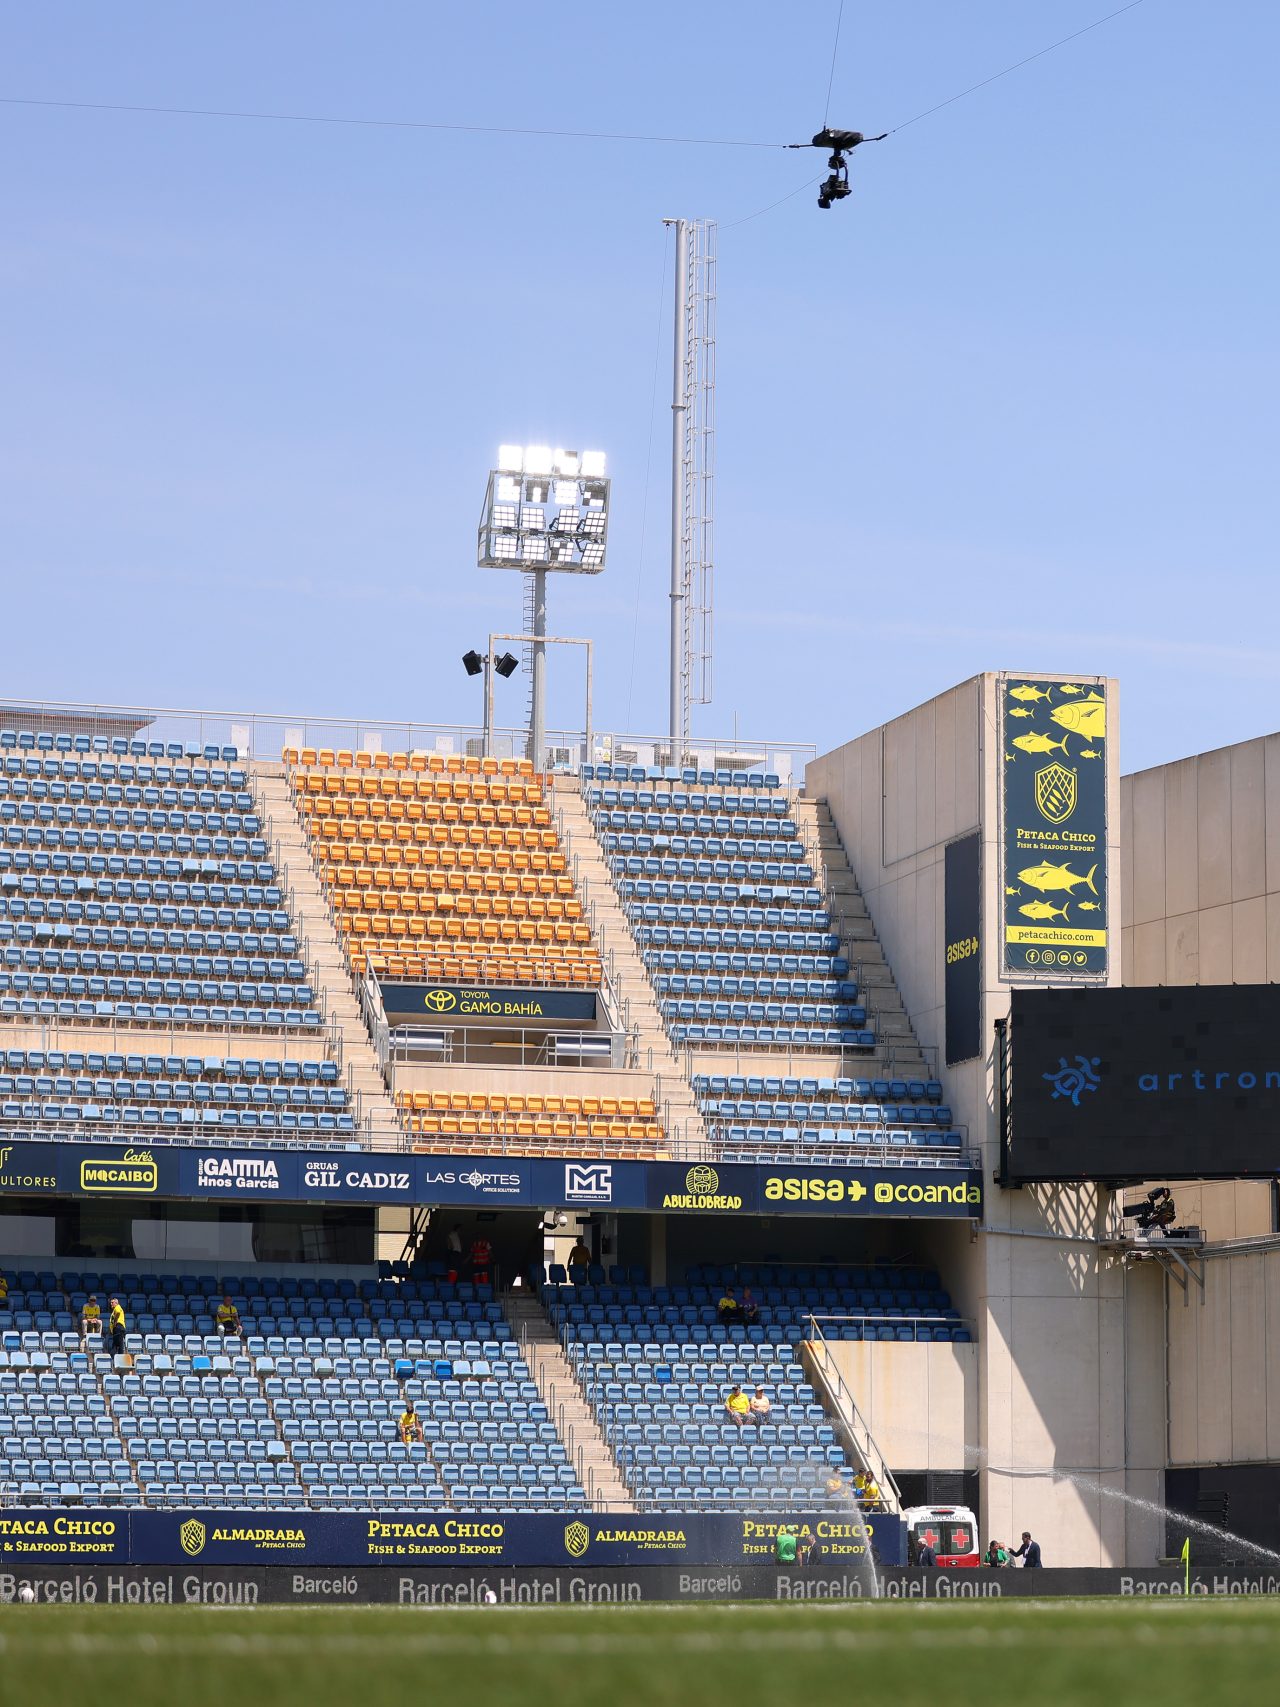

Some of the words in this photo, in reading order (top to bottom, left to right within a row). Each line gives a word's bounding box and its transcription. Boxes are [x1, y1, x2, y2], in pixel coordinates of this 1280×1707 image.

[1018, 930, 1095, 942] petacachico.com
[461, 991, 490, 999] TOYOTA
[460, 1001, 502, 1014] GAMO
[505, 1001, 543, 1015] BAHÍA
[123, 1148, 154, 1162] Cafés
[306, 1162, 339, 1171] GRUAS
[198, 1175, 232, 1188] Hnos
[236, 1177, 280, 1189] García
[304, 1172, 341, 1188] GIL
[345, 1172, 410, 1189] CADIZ
[426, 1172, 455, 1183] LAS
[662, 1193, 743, 1210] ABUELOBREAD
[919, 1513, 967, 1521] AMBULANCIA
[53, 1517, 116, 1536] CHICO
[367, 1520, 440, 1538] PETACA
[444, 1520, 504, 1538] CHICO
[211, 1528, 306, 1541] ALMADRABA
[595, 1530, 687, 1542] ALMADRABA
[367, 1543, 394, 1554] FISH
[396, 1544, 406, 1554] &
[408, 1543, 456, 1554] SEAFOOD
[459, 1543, 503, 1554] EXPORT
[107, 1576, 173, 1604] Hotel
[292, 1575, 358, 1595] Barceló
[501, 1578, 561, 1603] Hotel
[679, 1575, 742, 1593] Barceló
[777, 1576, 862, 1599] Barceló
